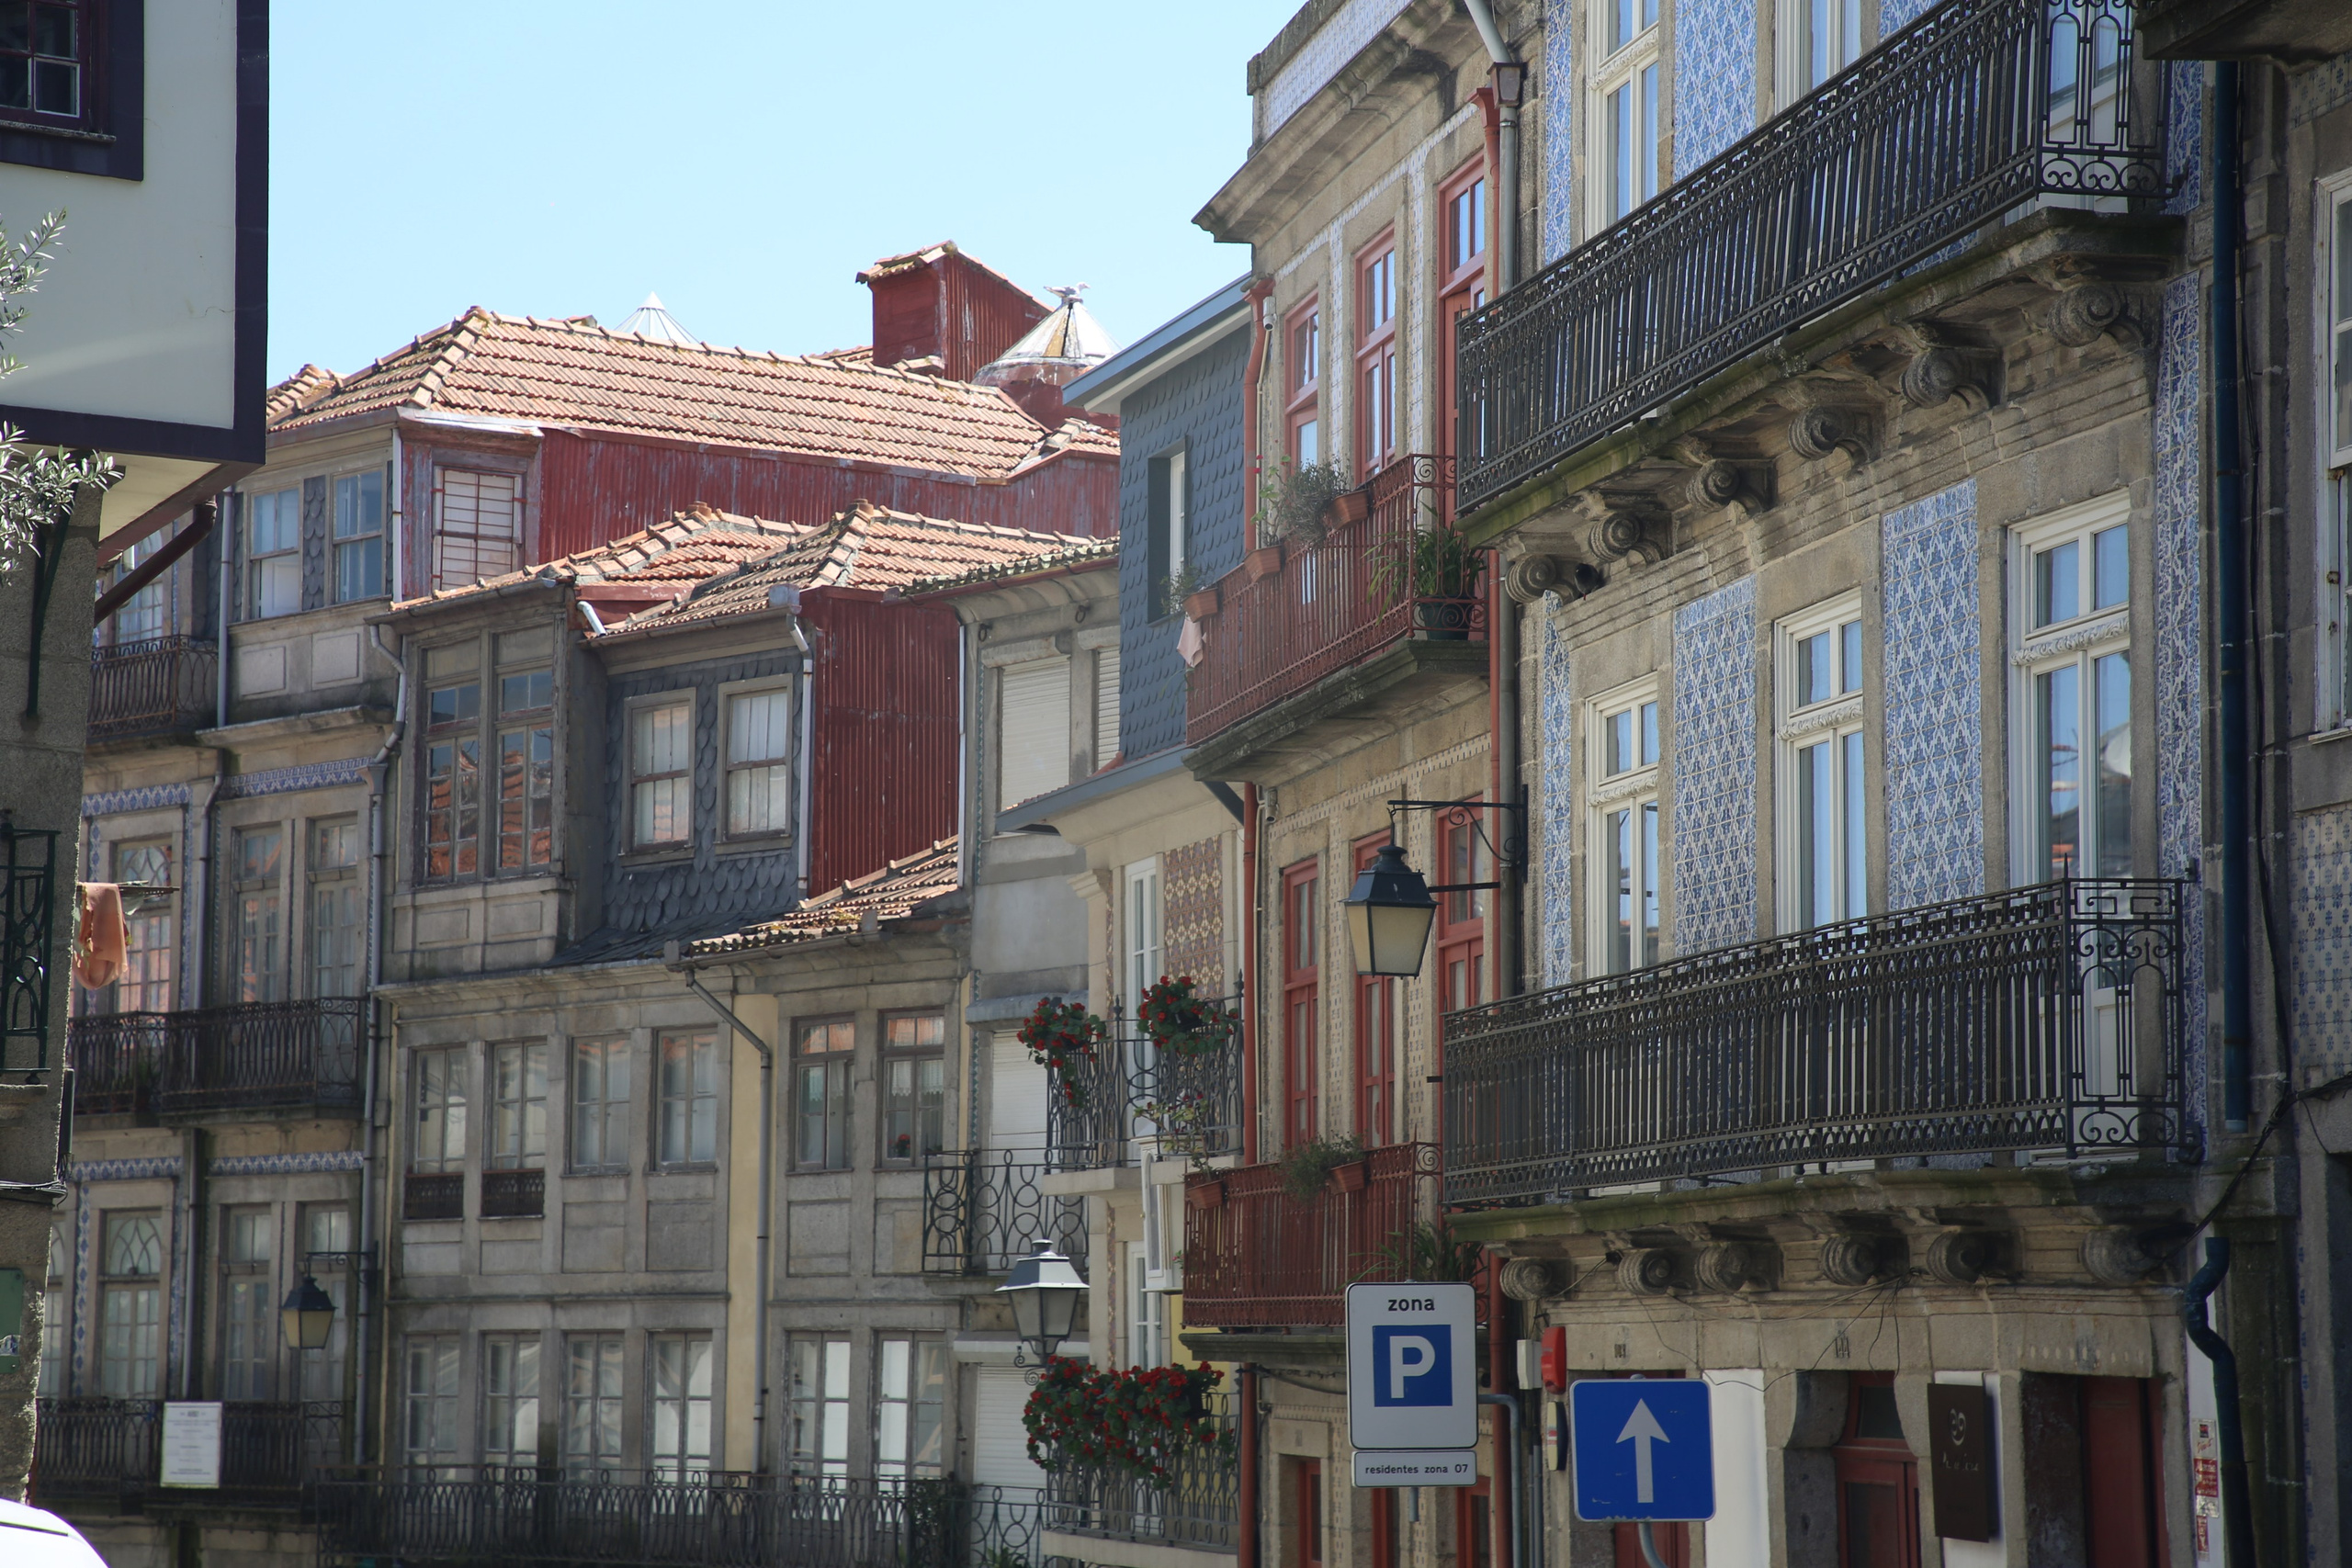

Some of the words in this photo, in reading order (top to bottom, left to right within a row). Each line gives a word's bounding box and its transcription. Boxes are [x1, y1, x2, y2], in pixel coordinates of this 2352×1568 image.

[1387, 1298, 1435, 1312] zona
[1389, 1336, 1436, 1399] P
[1365, 1464, 1419, 1474] residentes
[1424, 1465, 1448, 1473] zona
[1454, 1464, 1468, 1473] 07
